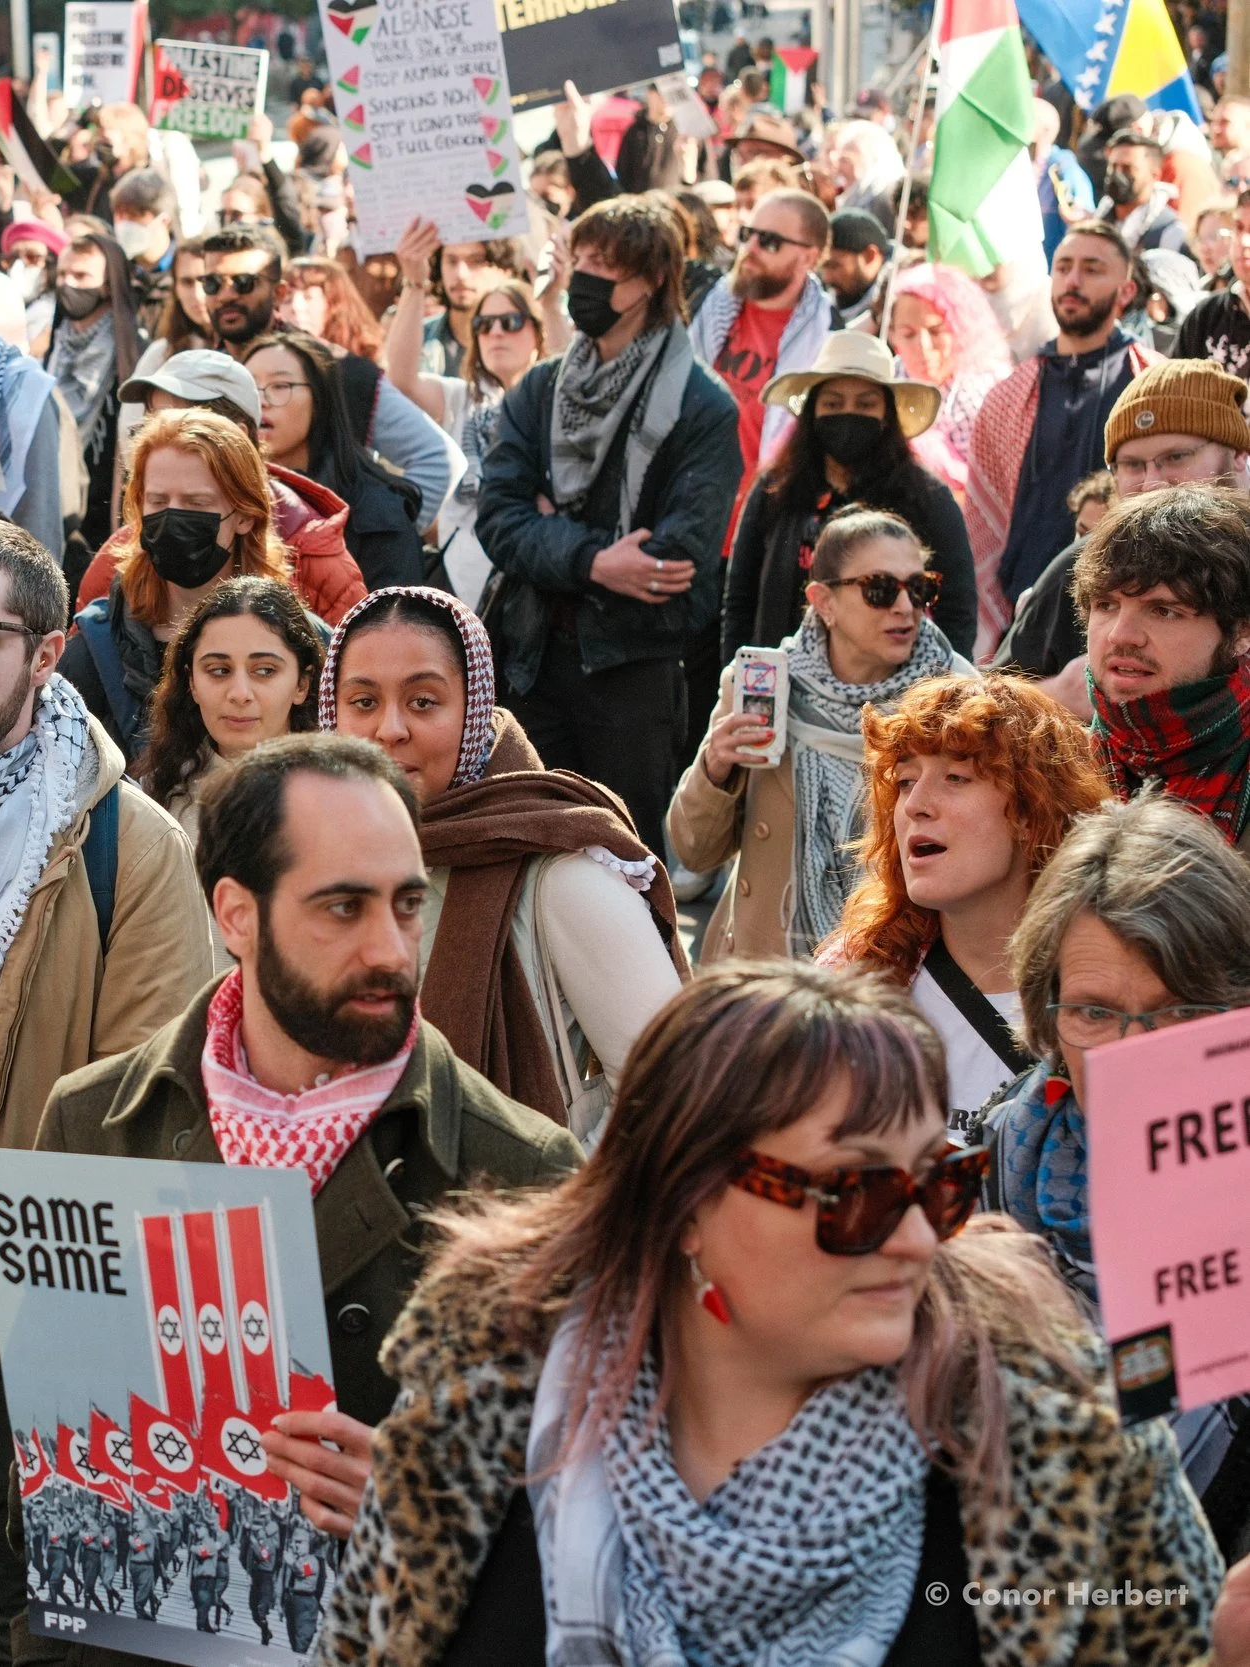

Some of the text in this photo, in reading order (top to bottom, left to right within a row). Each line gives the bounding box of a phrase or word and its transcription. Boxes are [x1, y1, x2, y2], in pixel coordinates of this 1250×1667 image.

[376, 7, 472, 37] ALBANESE
[162, 75, 255, 112] DESERVES
[1154, 1249, 1242, 1306] FREE
[44, 1611, 87, 1634] FPP
